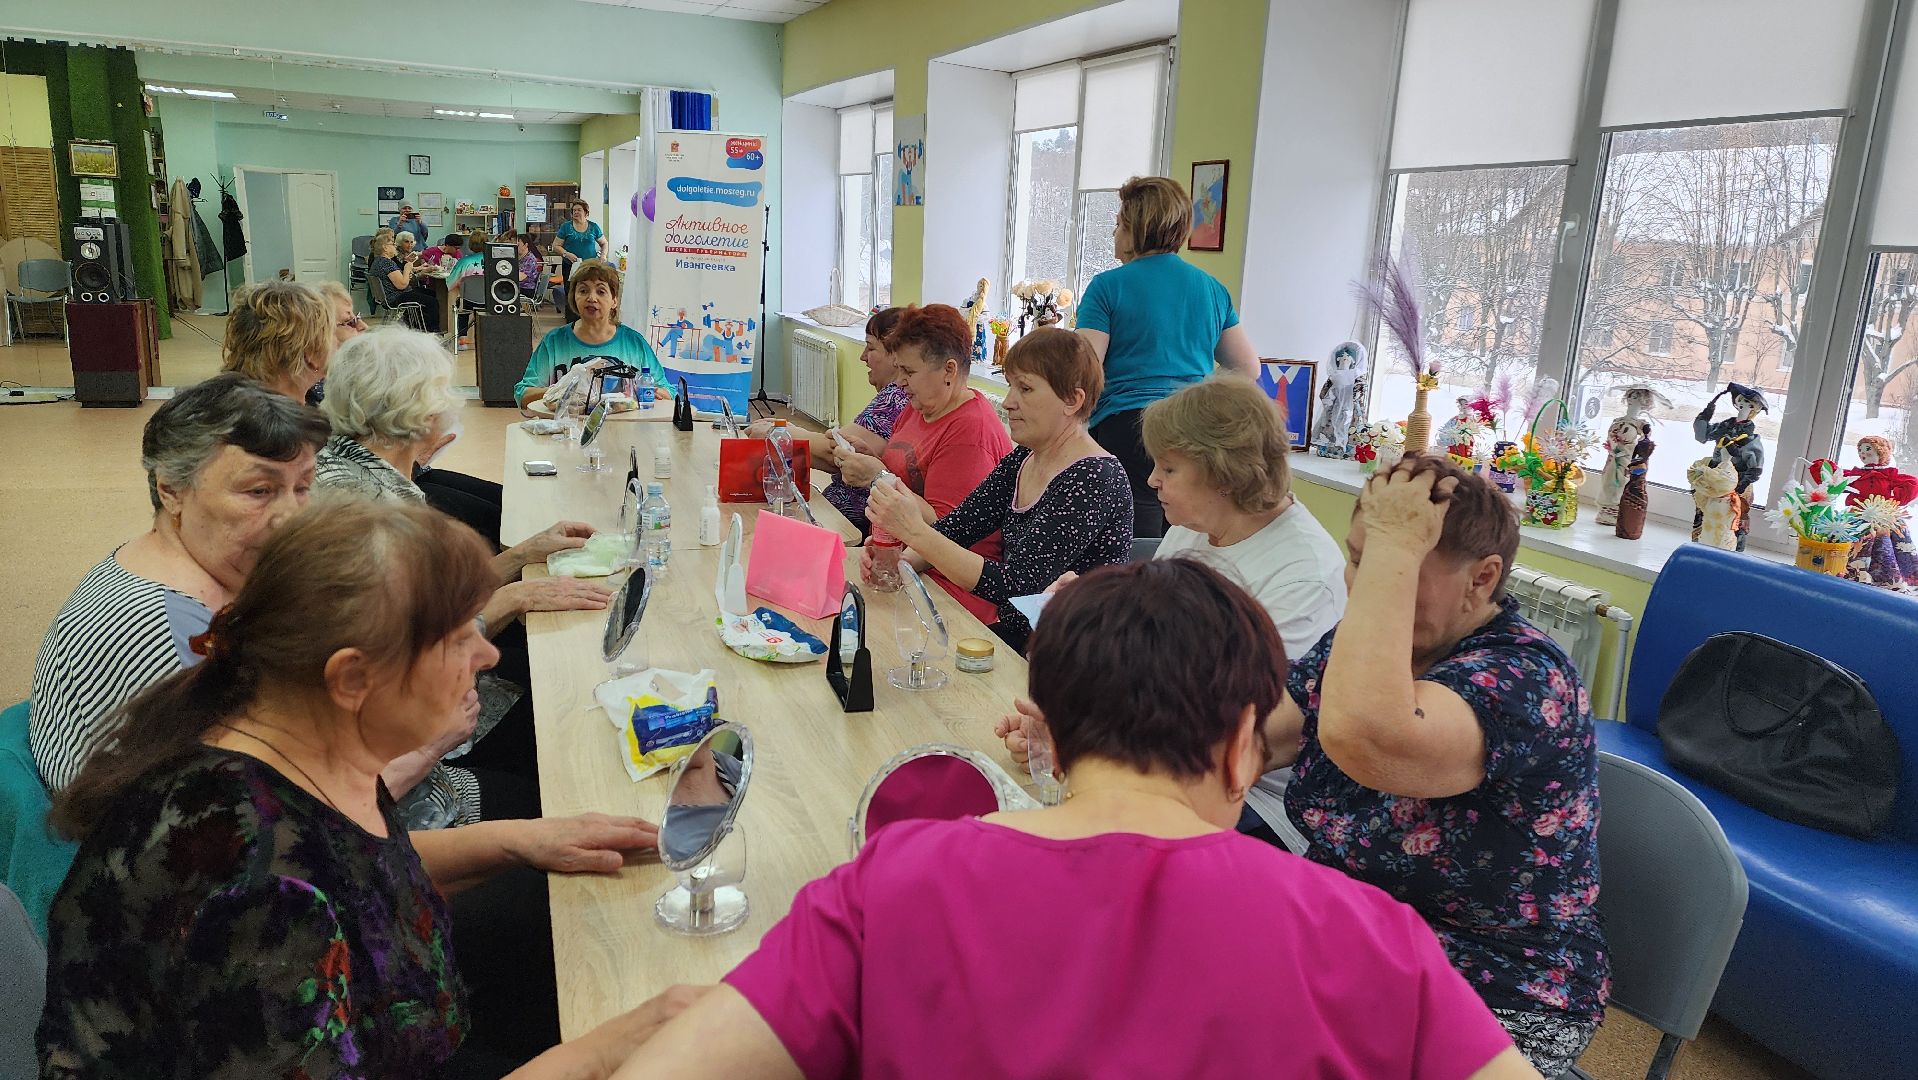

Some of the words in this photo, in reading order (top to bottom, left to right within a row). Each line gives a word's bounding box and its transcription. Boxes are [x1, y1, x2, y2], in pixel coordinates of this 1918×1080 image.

[746, 153, 760, 161] 60+
[676, 185, 755, 197] dolgoletie.mosreg.ru
[666, 214, 748, 234] Активное
[665, 228, 749, 248] долголетие
[675, 259, 736, 272] Ивантеевка
